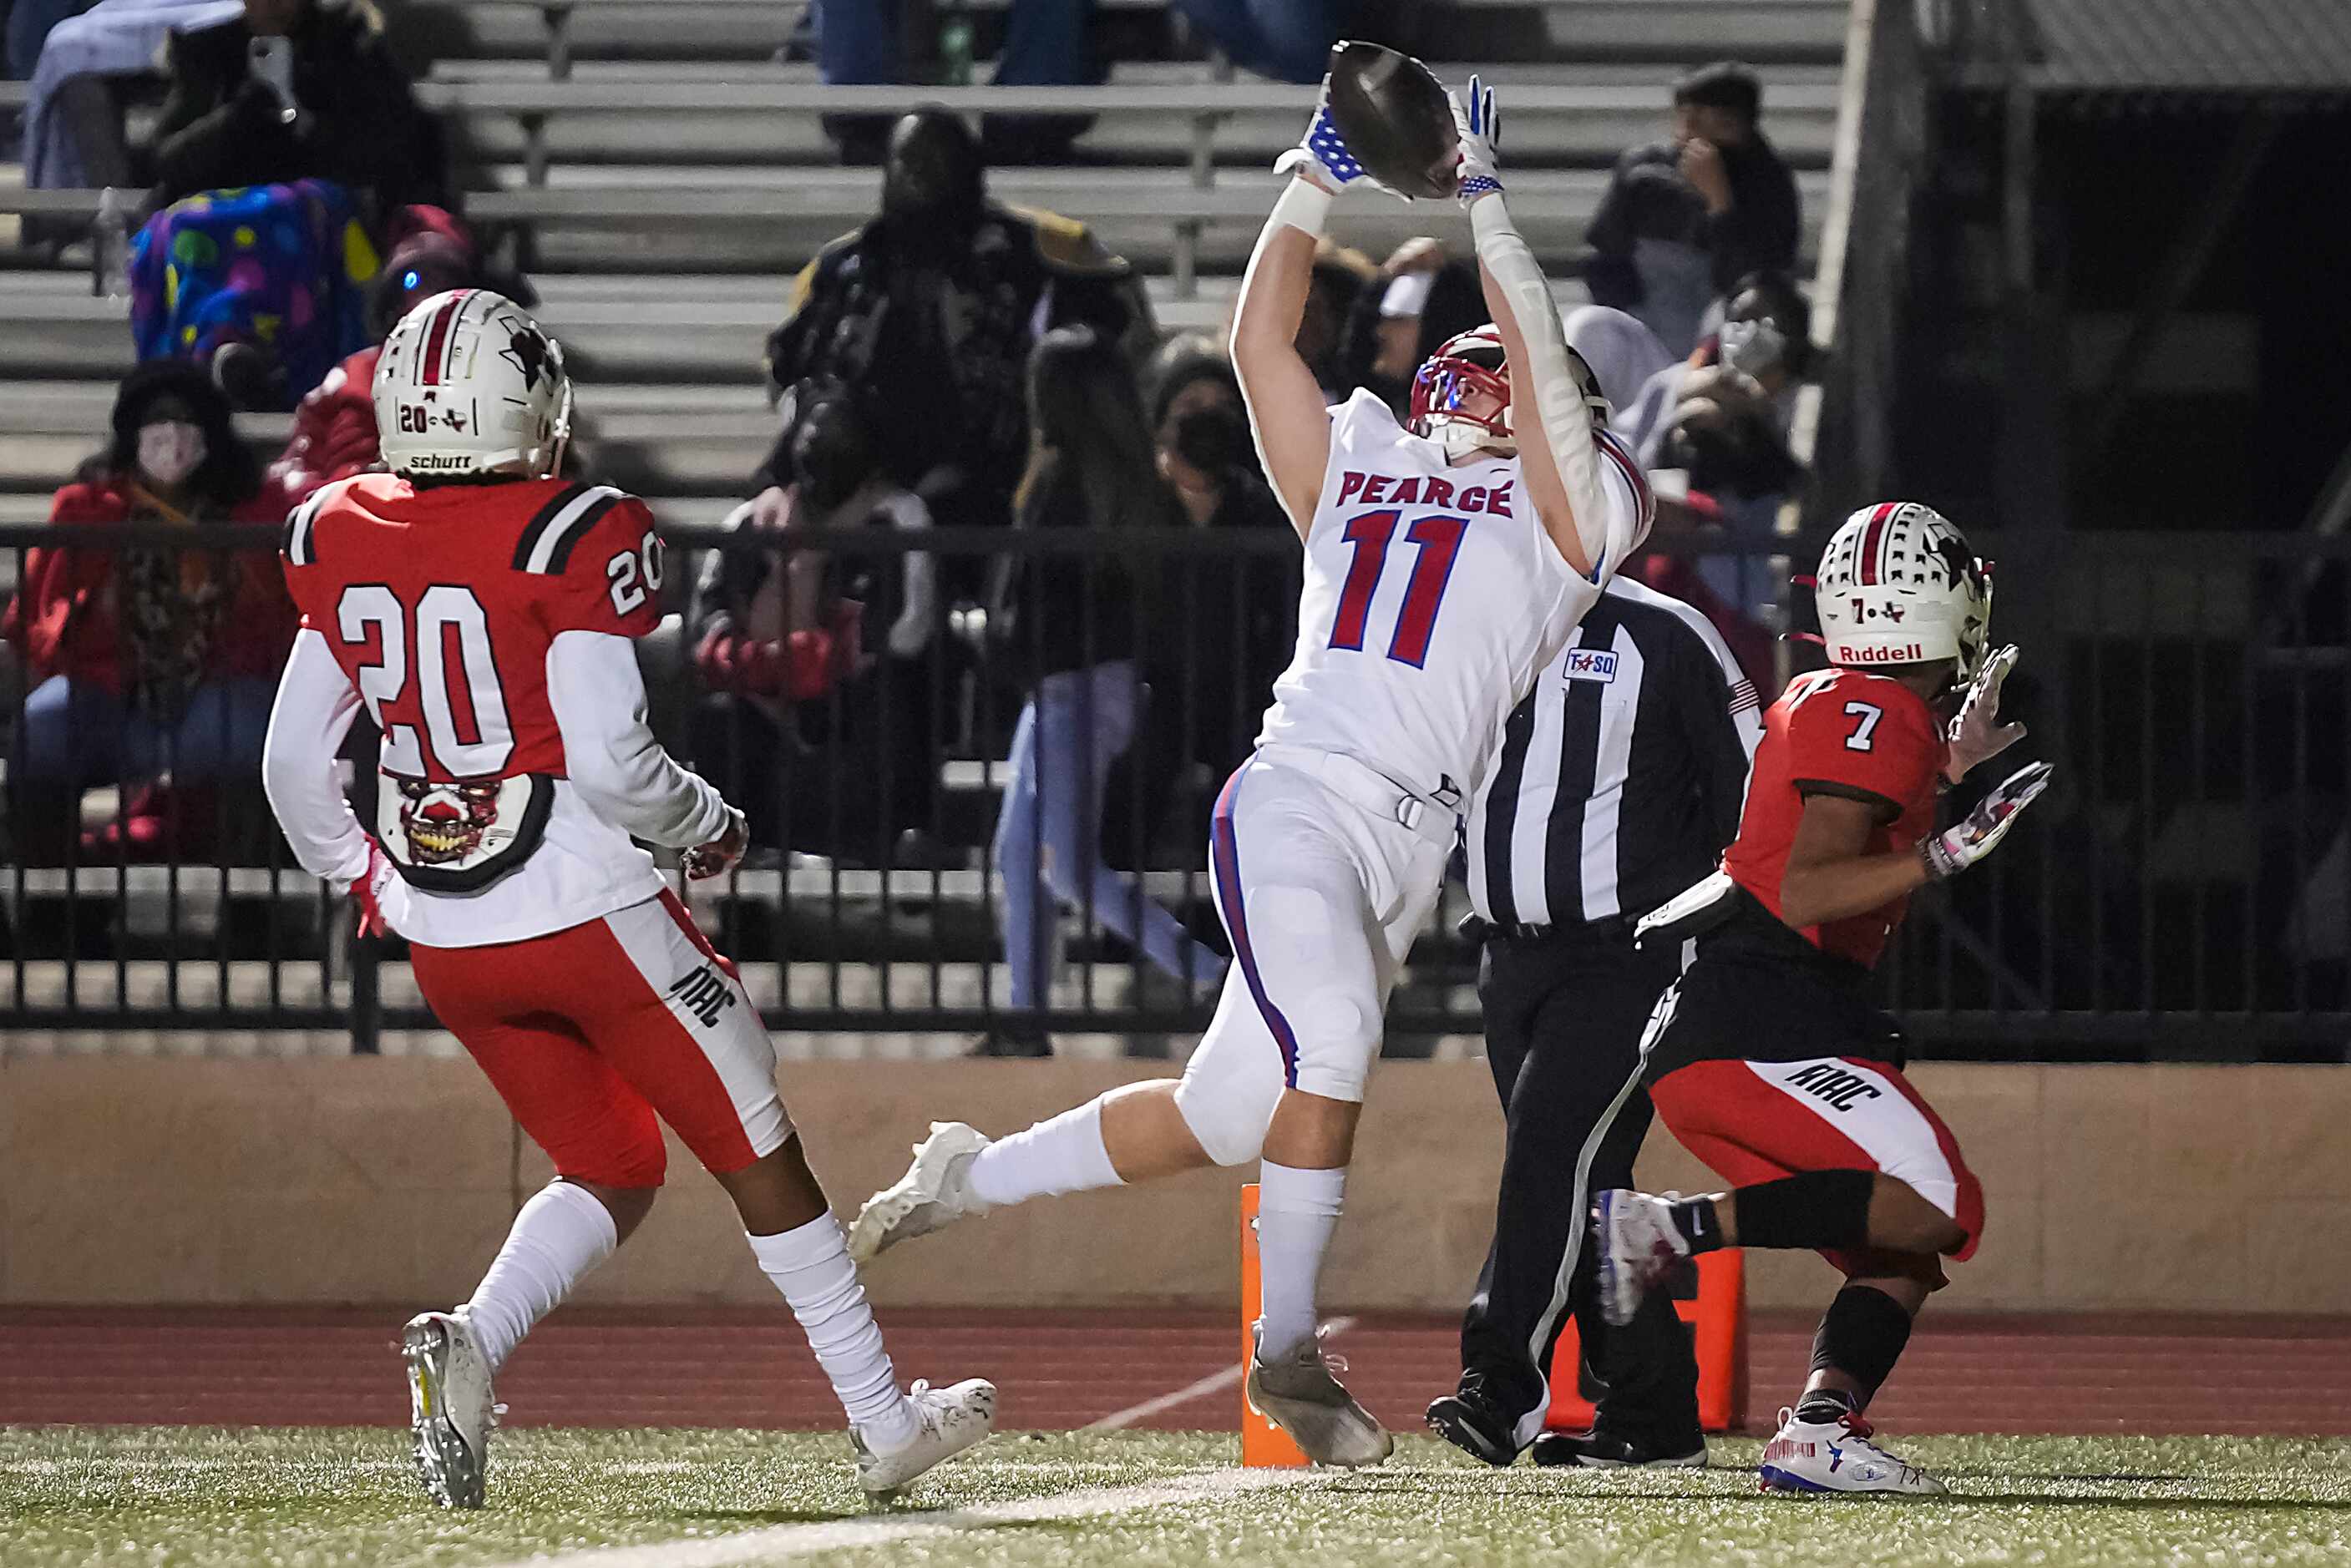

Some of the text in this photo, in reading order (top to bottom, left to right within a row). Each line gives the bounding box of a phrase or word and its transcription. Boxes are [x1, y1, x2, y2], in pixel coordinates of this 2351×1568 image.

[401, 404, 428, 432] 20
[1336, 471, 1512, 518] PEARCE
[606, 530, 663, 616] 20
[1327, 509, 1470, 670] 11
[1852, 598, 1864, 625] 7
[1839, 644, 1922, 662] Riddell
[337, 583, 515, 777] 20
[1843, 701, 1882, 752] 7
